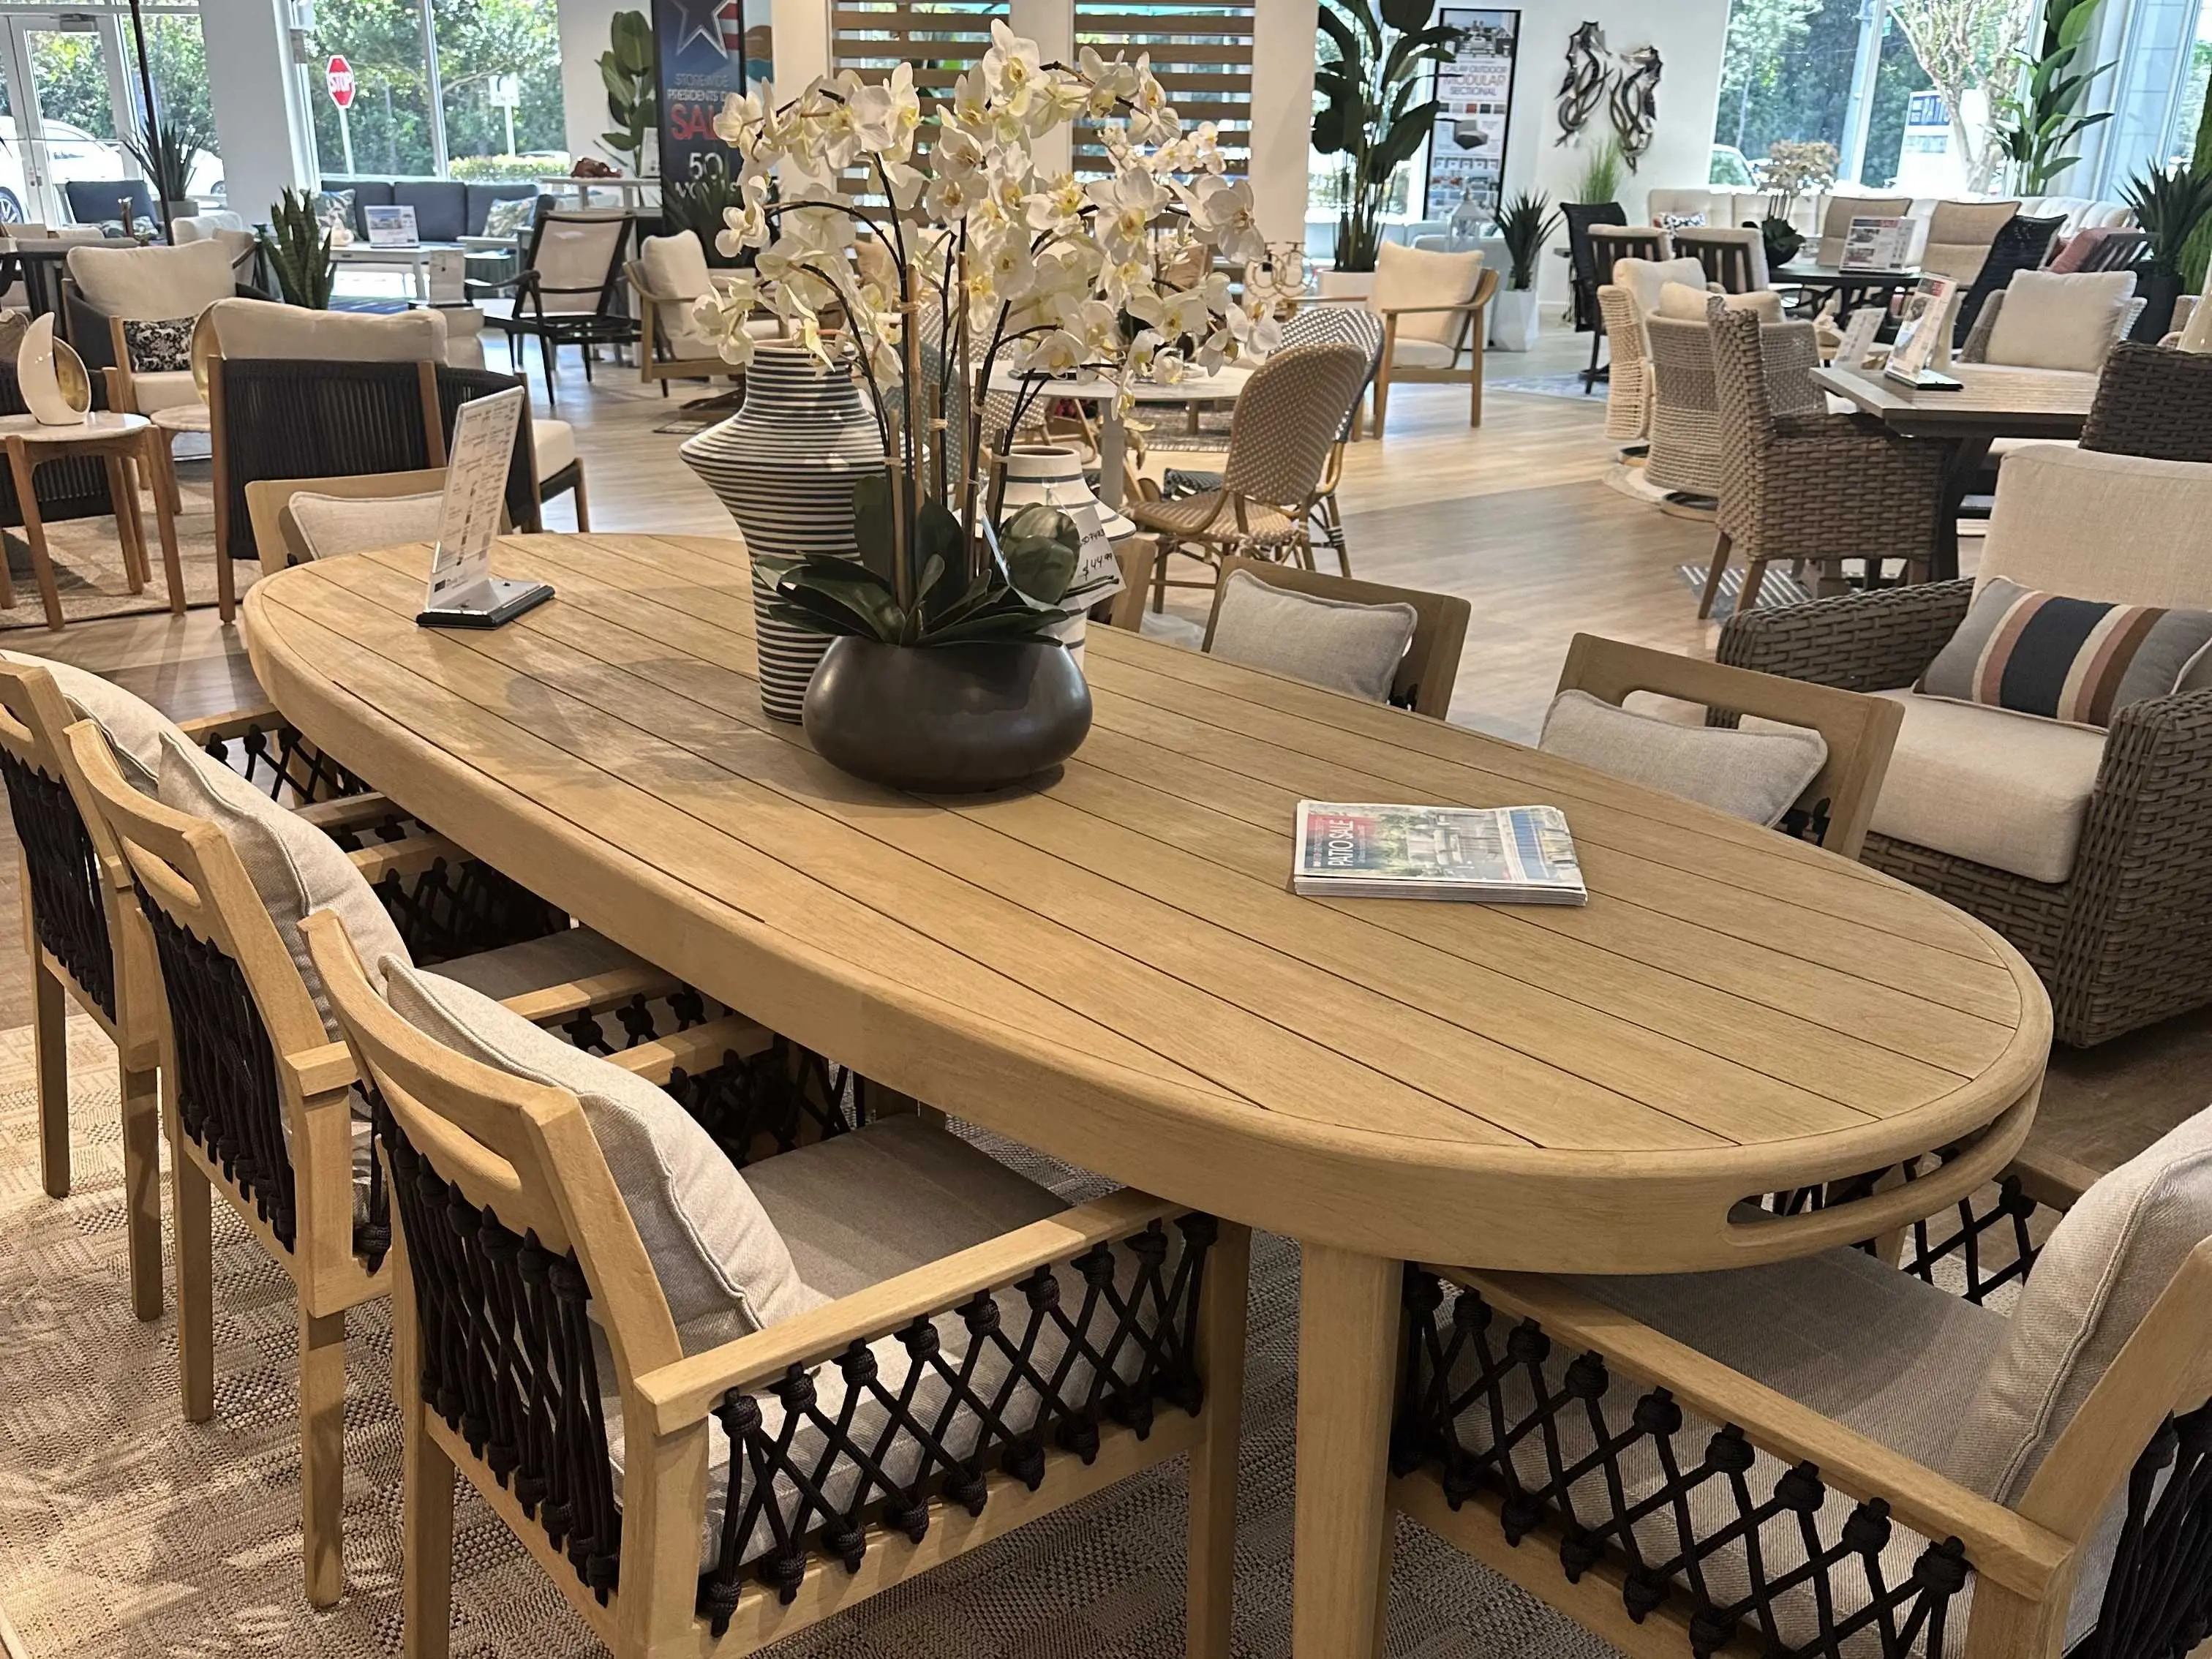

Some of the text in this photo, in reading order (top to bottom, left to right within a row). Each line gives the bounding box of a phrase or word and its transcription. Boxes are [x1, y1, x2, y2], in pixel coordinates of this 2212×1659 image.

[329, 72, 353, 92] STOP
[670, 103, 721, 140] SAL
[1328, 819, 1354, 867] PATIO SALE
